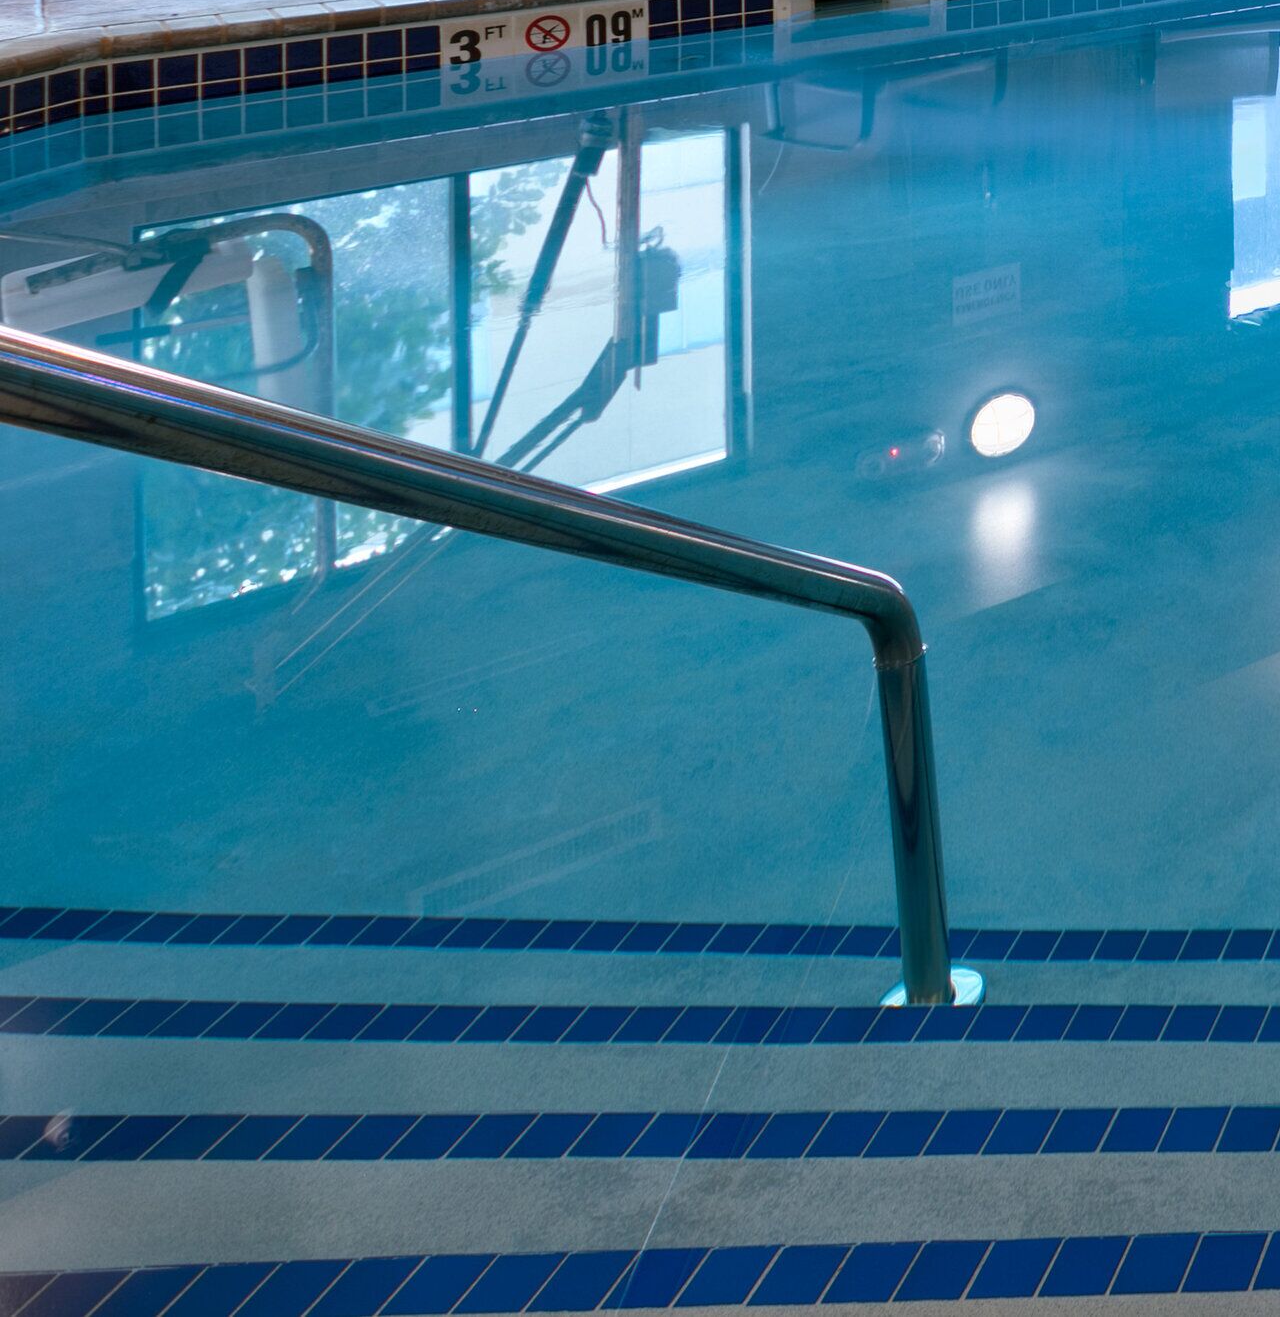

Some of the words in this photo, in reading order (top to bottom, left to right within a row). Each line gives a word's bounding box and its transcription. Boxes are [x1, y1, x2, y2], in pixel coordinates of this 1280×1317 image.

[450, 29, 482, 65] 3
[485, 25, 507, 41] FT
[632, 8, 644, 19] M
